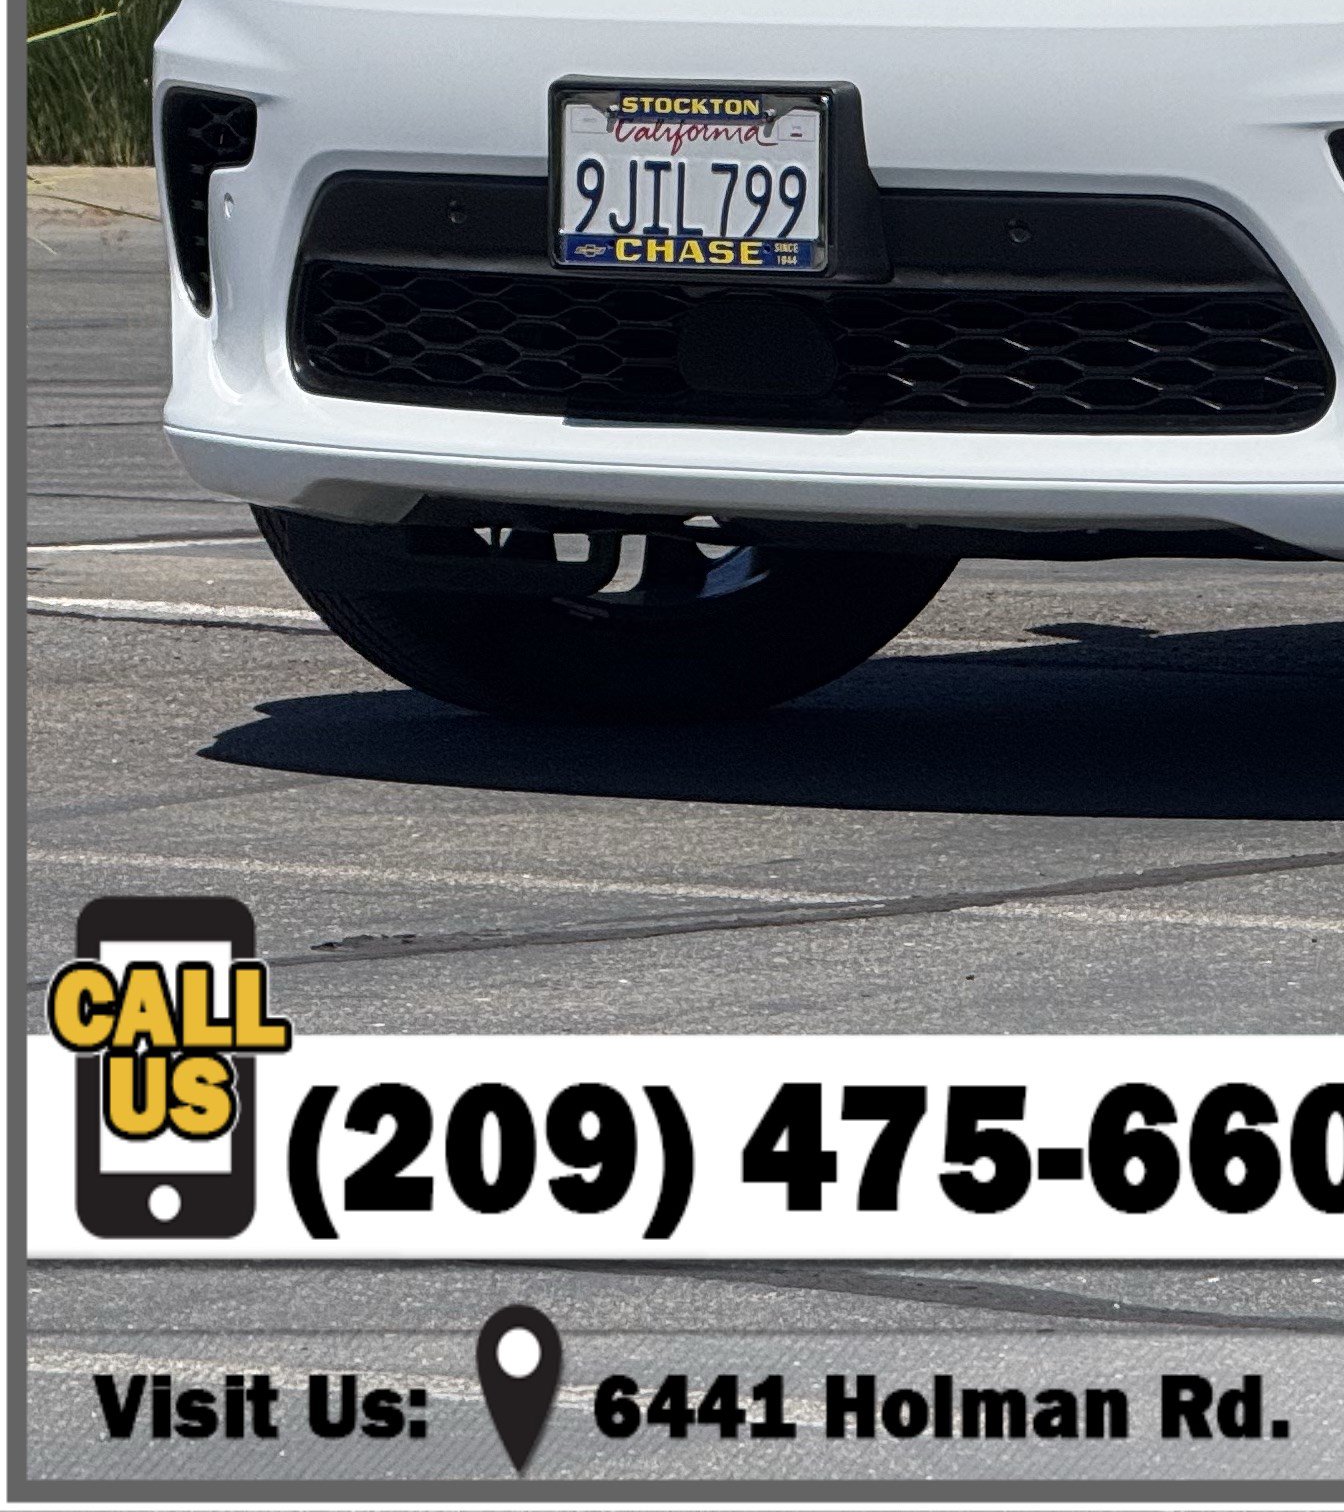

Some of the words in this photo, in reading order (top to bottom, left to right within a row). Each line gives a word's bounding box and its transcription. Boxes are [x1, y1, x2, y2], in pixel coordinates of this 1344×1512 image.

[621, 96, 761, 117] STOCKTON
[614, 119, 778, 156] California
[575, 157, 808, 238] 9JIL799
[615, 238, 764, 266] CHASE
